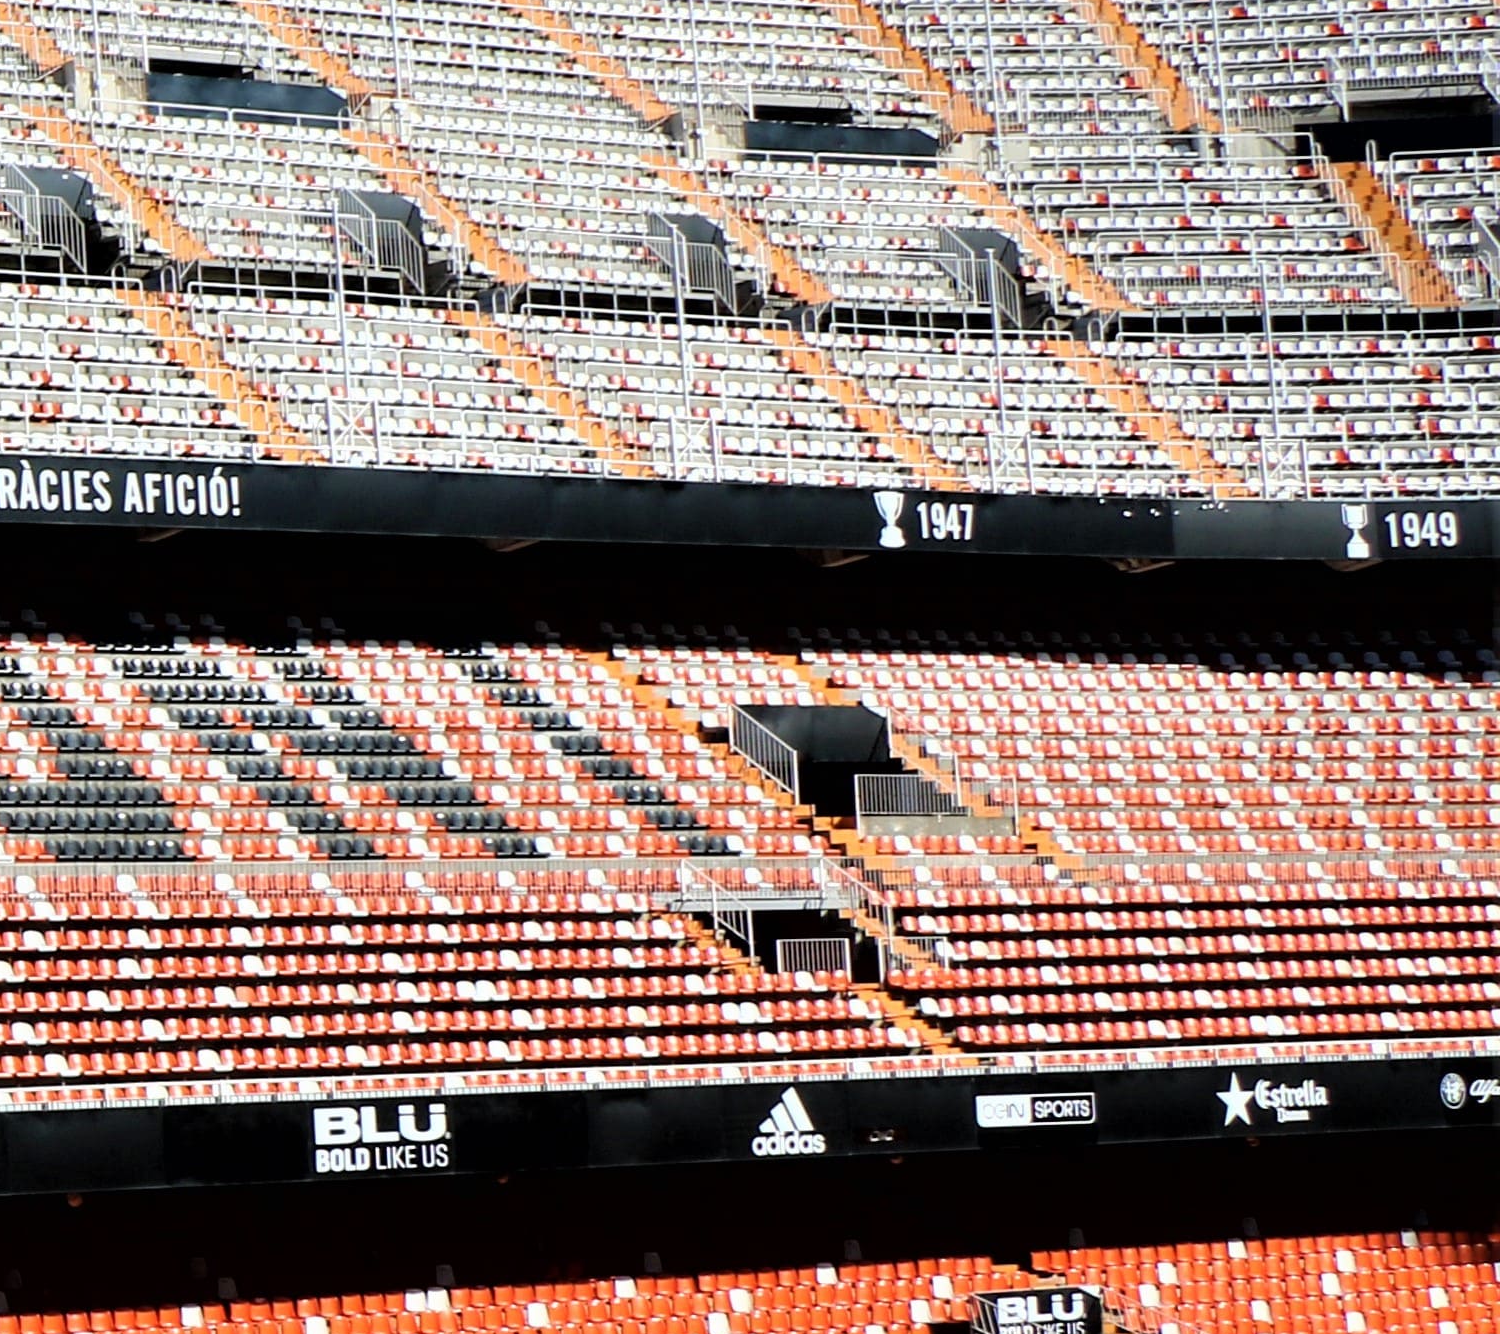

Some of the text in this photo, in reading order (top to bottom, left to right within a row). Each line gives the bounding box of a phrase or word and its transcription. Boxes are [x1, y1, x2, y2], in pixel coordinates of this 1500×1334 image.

[123, 467, 241, 517] AFICIÓ!
[916, 501, 974, 541] 1947
[1384, 511, 1458, 548] 1949
[1034, 1099, 1090, 1119] SPORTS
[1254, 1079, 1329, 1109] Estrella
[315, 1143, 449, 1173] BOLD LIKE US
[752, 1131, 826, 1156] adidas
